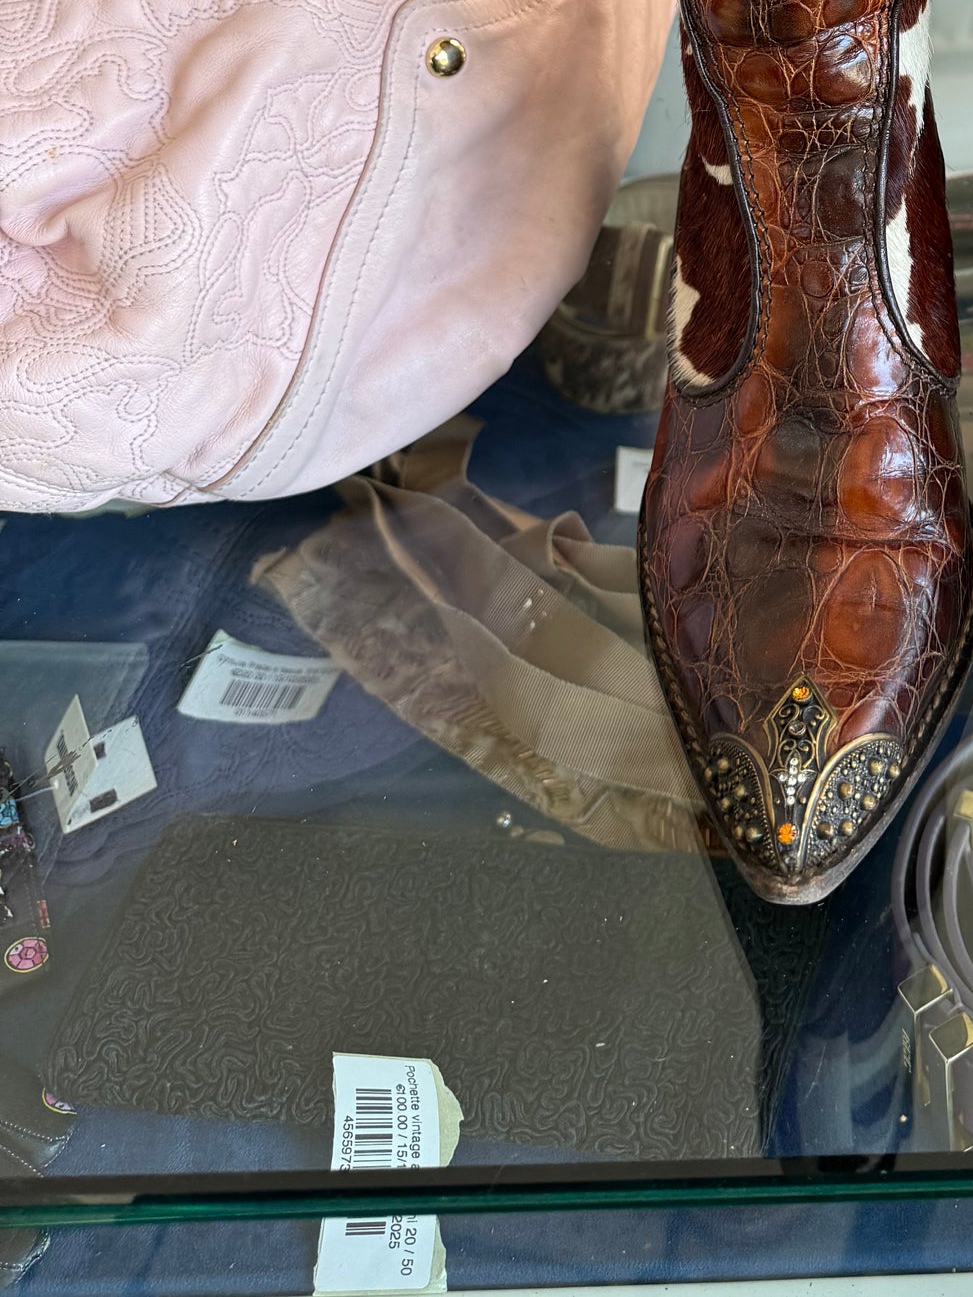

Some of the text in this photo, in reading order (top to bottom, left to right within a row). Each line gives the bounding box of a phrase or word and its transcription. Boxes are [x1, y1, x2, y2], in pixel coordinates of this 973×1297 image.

[405, 1065, 420, 1110] Pochette
[409, 1114, 422, 1158] vintage
[405, 1228, 417, 1245] 20
[400, 1258, 414, 1276] 50
